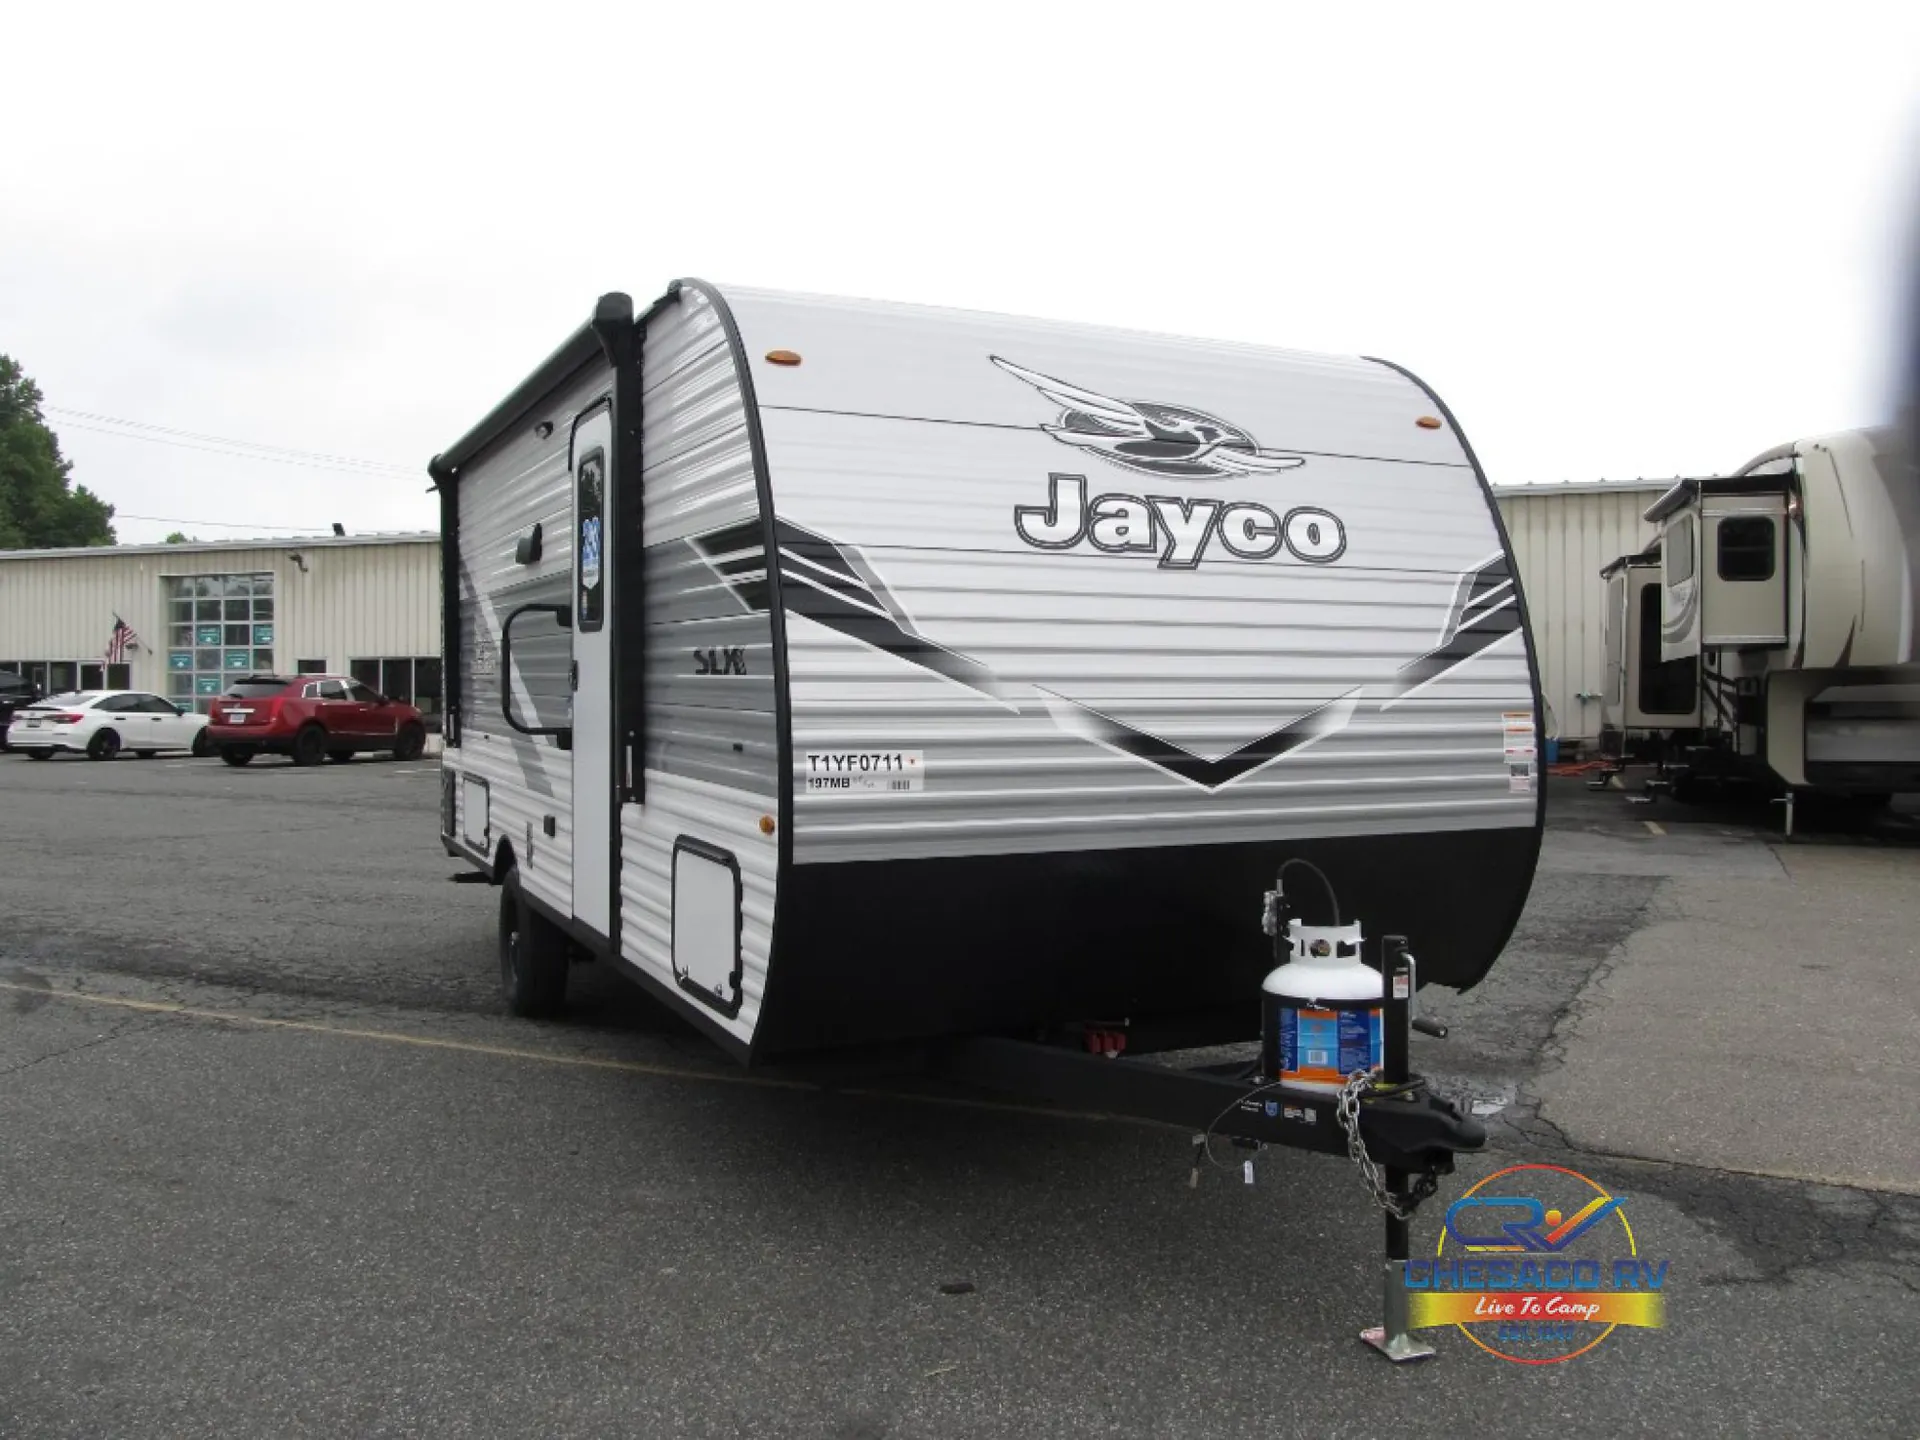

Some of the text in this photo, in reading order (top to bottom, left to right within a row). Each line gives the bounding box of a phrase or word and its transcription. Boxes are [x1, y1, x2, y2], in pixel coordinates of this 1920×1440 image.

[1013, 472, 1347, 571] Jayco
[808, 753, 902, 772] T1YF0711
[808, 777, 850, 789] 197MB
